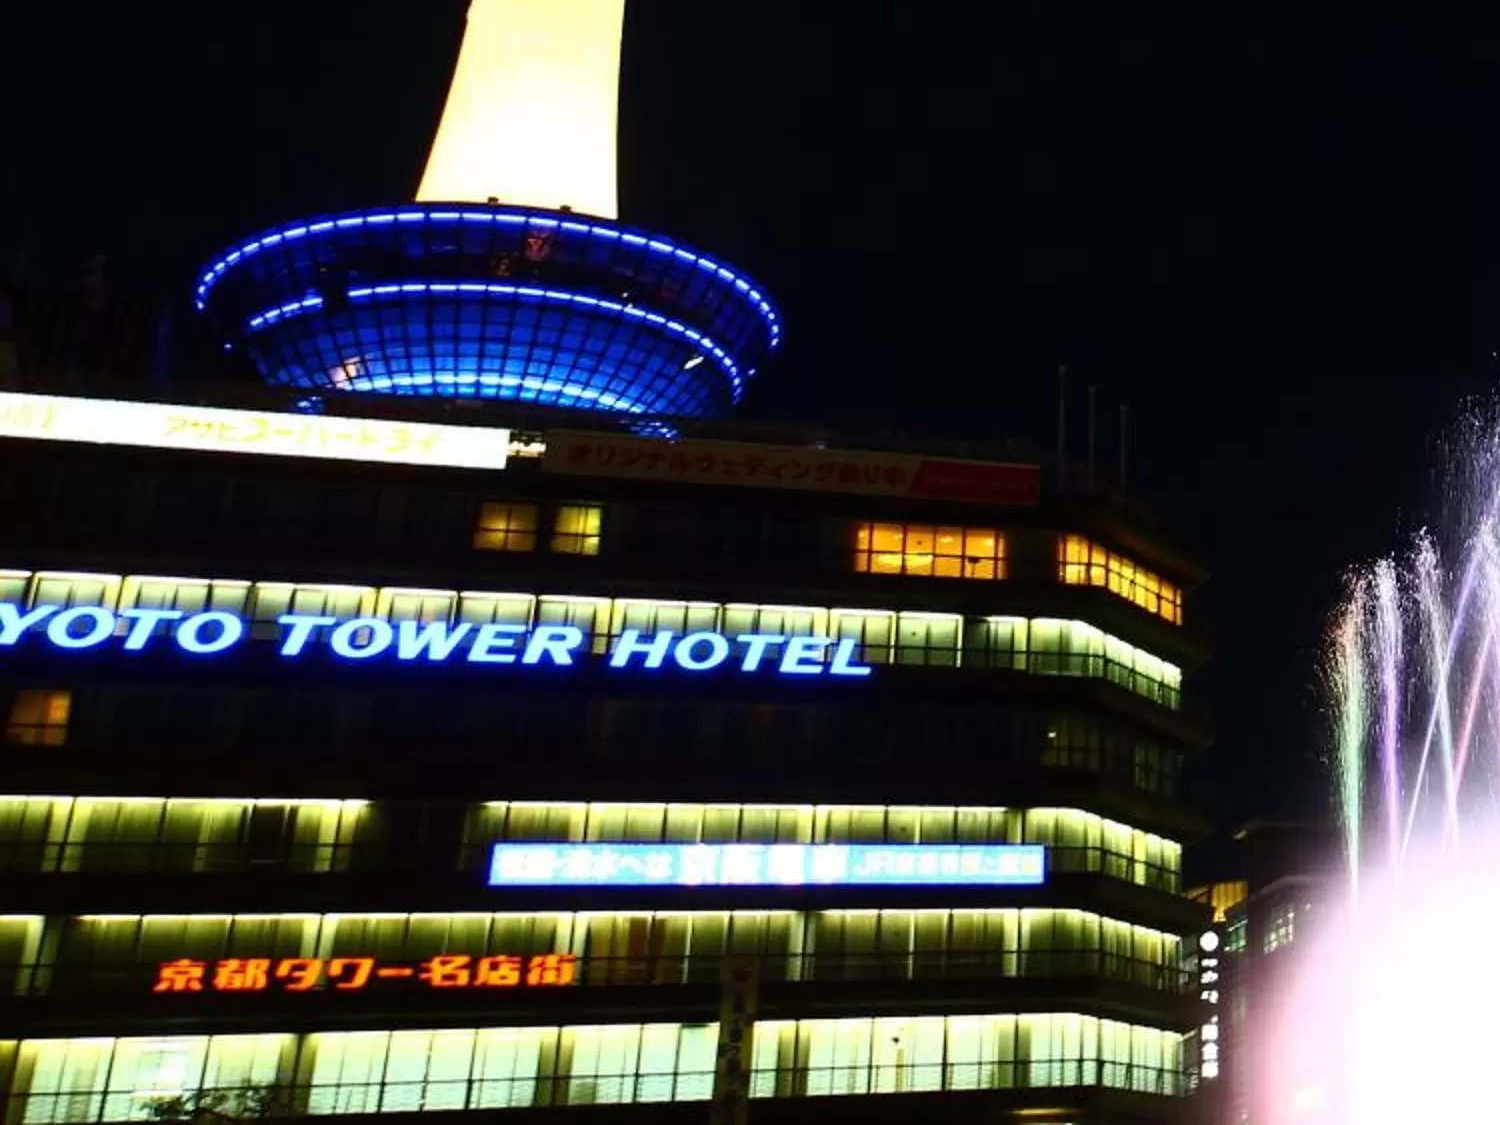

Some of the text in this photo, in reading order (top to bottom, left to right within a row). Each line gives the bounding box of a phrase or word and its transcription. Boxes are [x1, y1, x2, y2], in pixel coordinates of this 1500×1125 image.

[278, 615, 583, 666] TOWER
[609, 627, 873, 676] HOTEL
[155, 952, 577, 992] 京都タワー名店街
